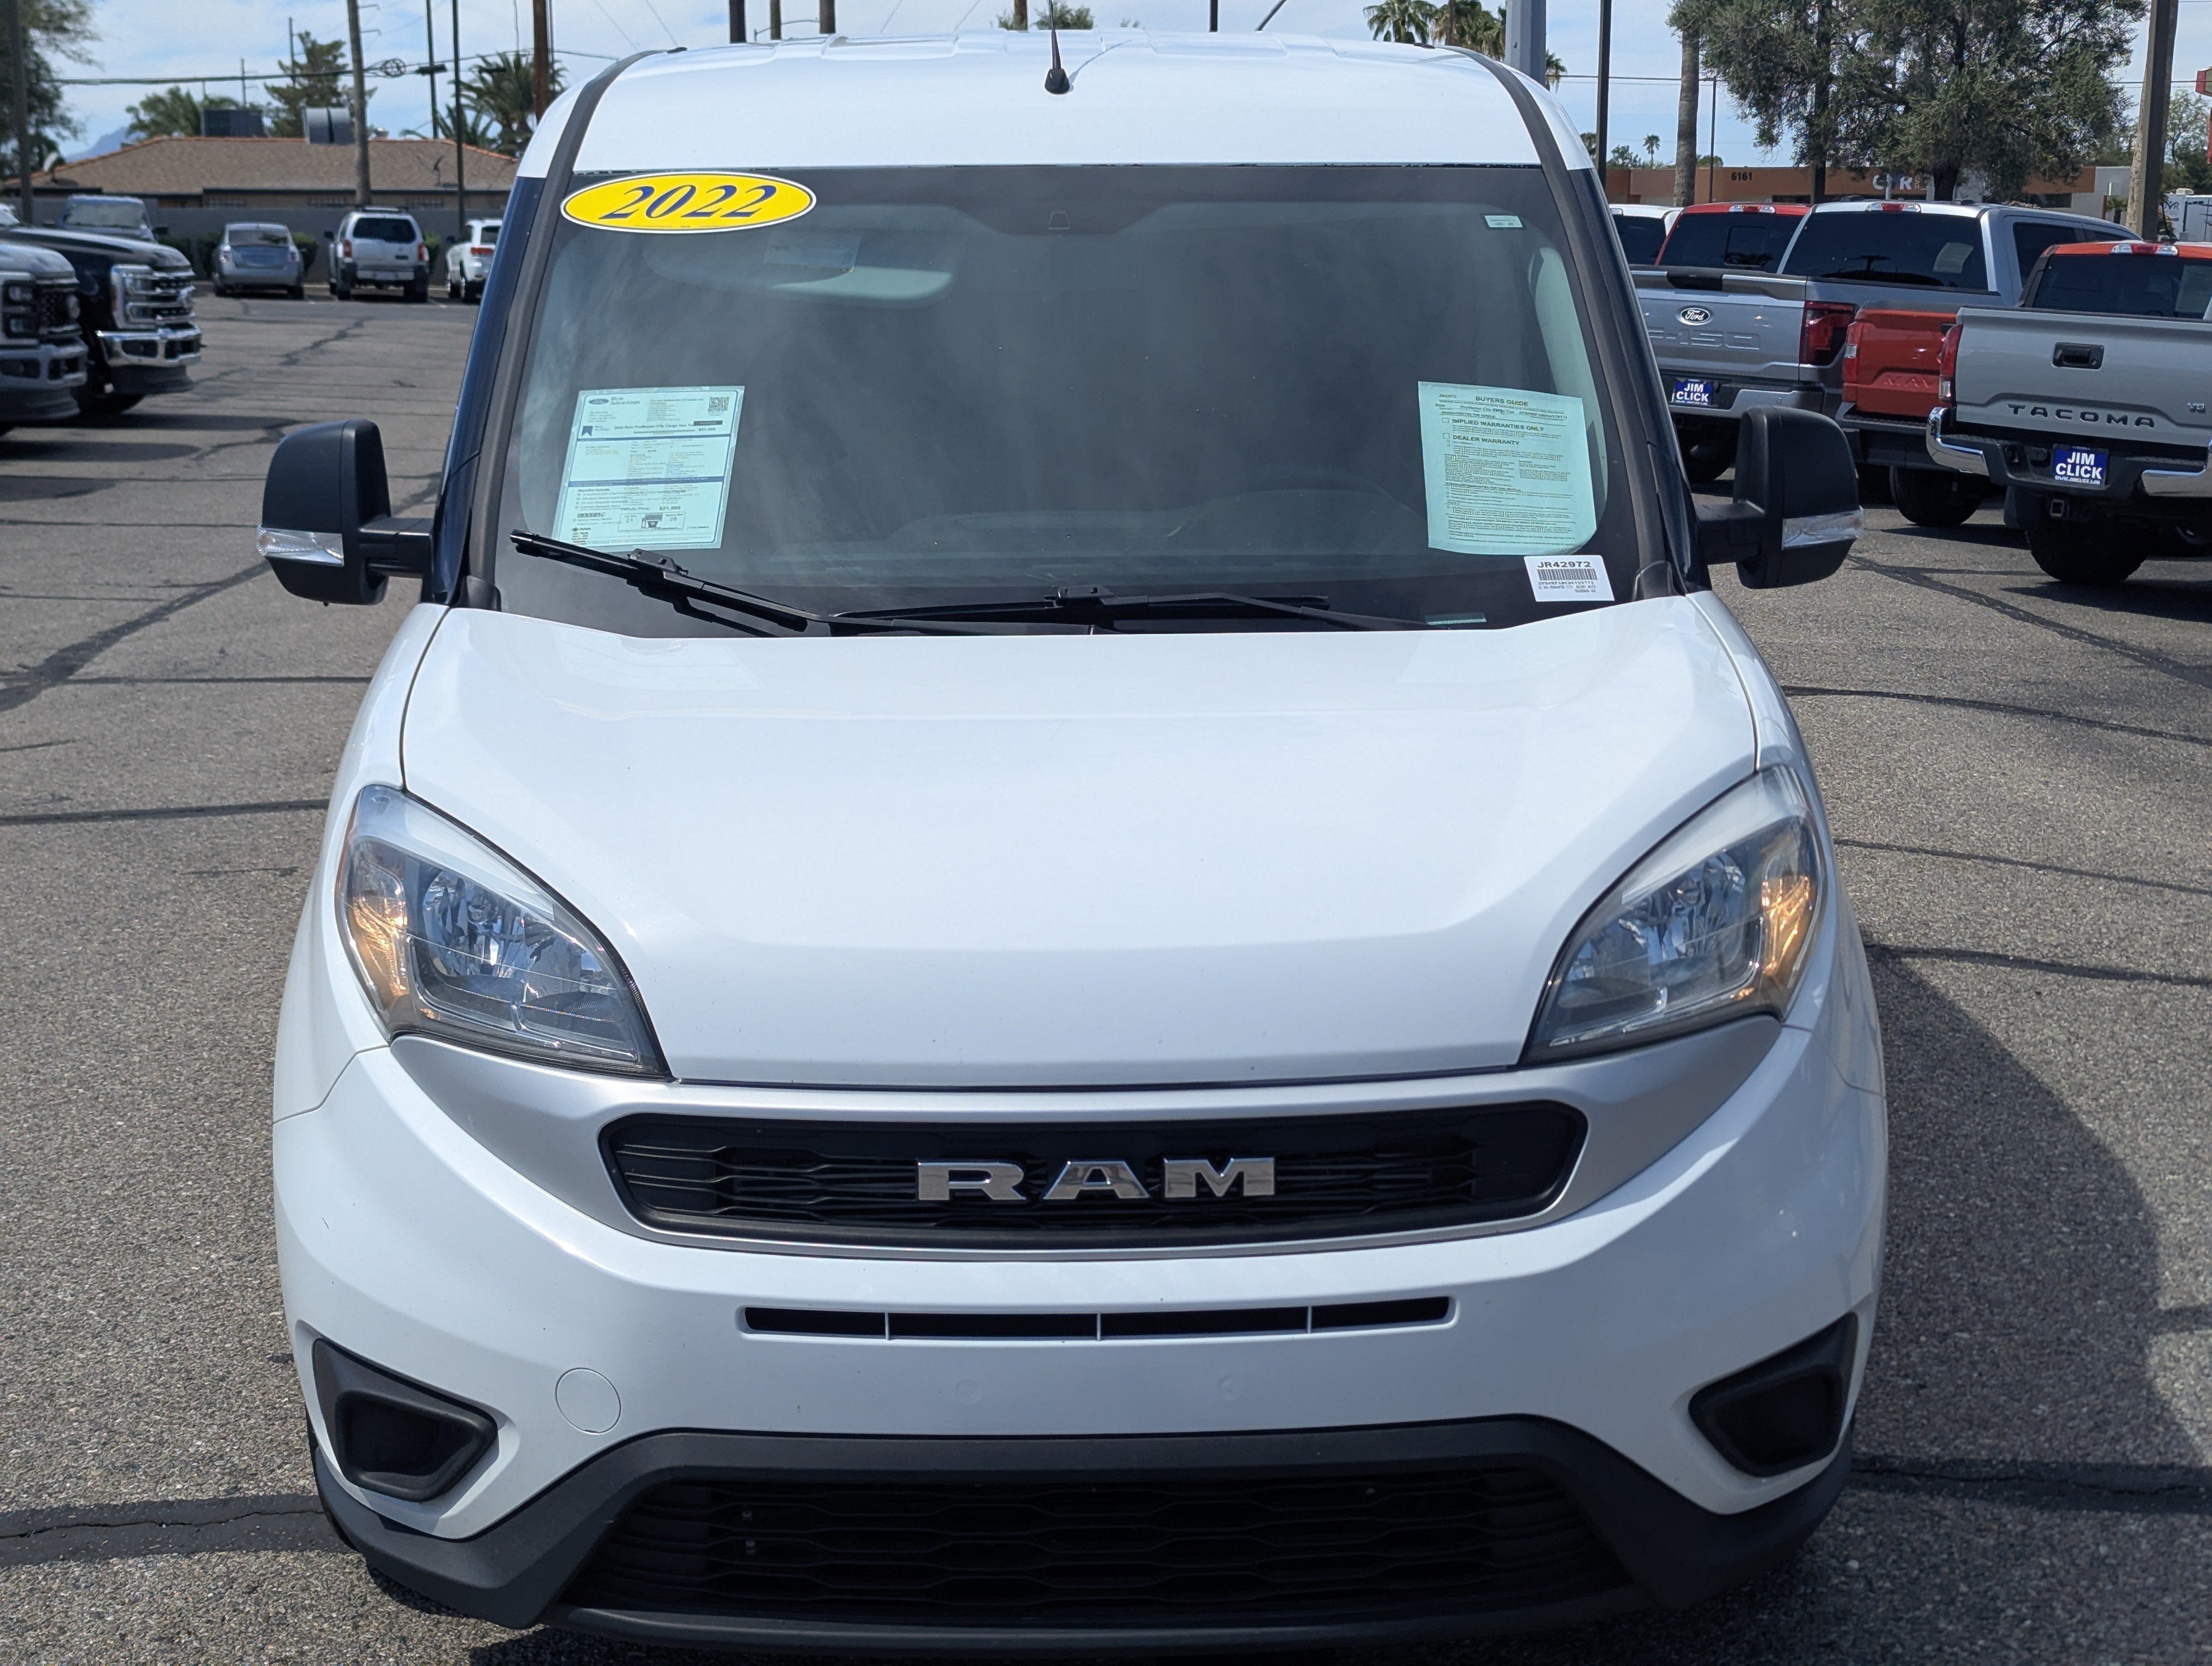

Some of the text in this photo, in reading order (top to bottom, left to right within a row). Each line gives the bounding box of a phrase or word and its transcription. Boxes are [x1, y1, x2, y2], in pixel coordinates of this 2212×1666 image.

[1731, 172, 1752, 181] 6161
[598, 185, 777, 220] 2022
[1684, 309, 1705, 321] Ford
[1683, 383, 1704, 393] JIM
[1676, 391, 1709, 402] CLICK
[2007, 404, 2155, 427] TACOMA
[1480, 421, 1525, 430] WARRANTIES
[2067, 452, 2095, 465] JIM
[2056, 463, 2102, 479] CLICK
[917, 1158, 1275, 1200] RAM
